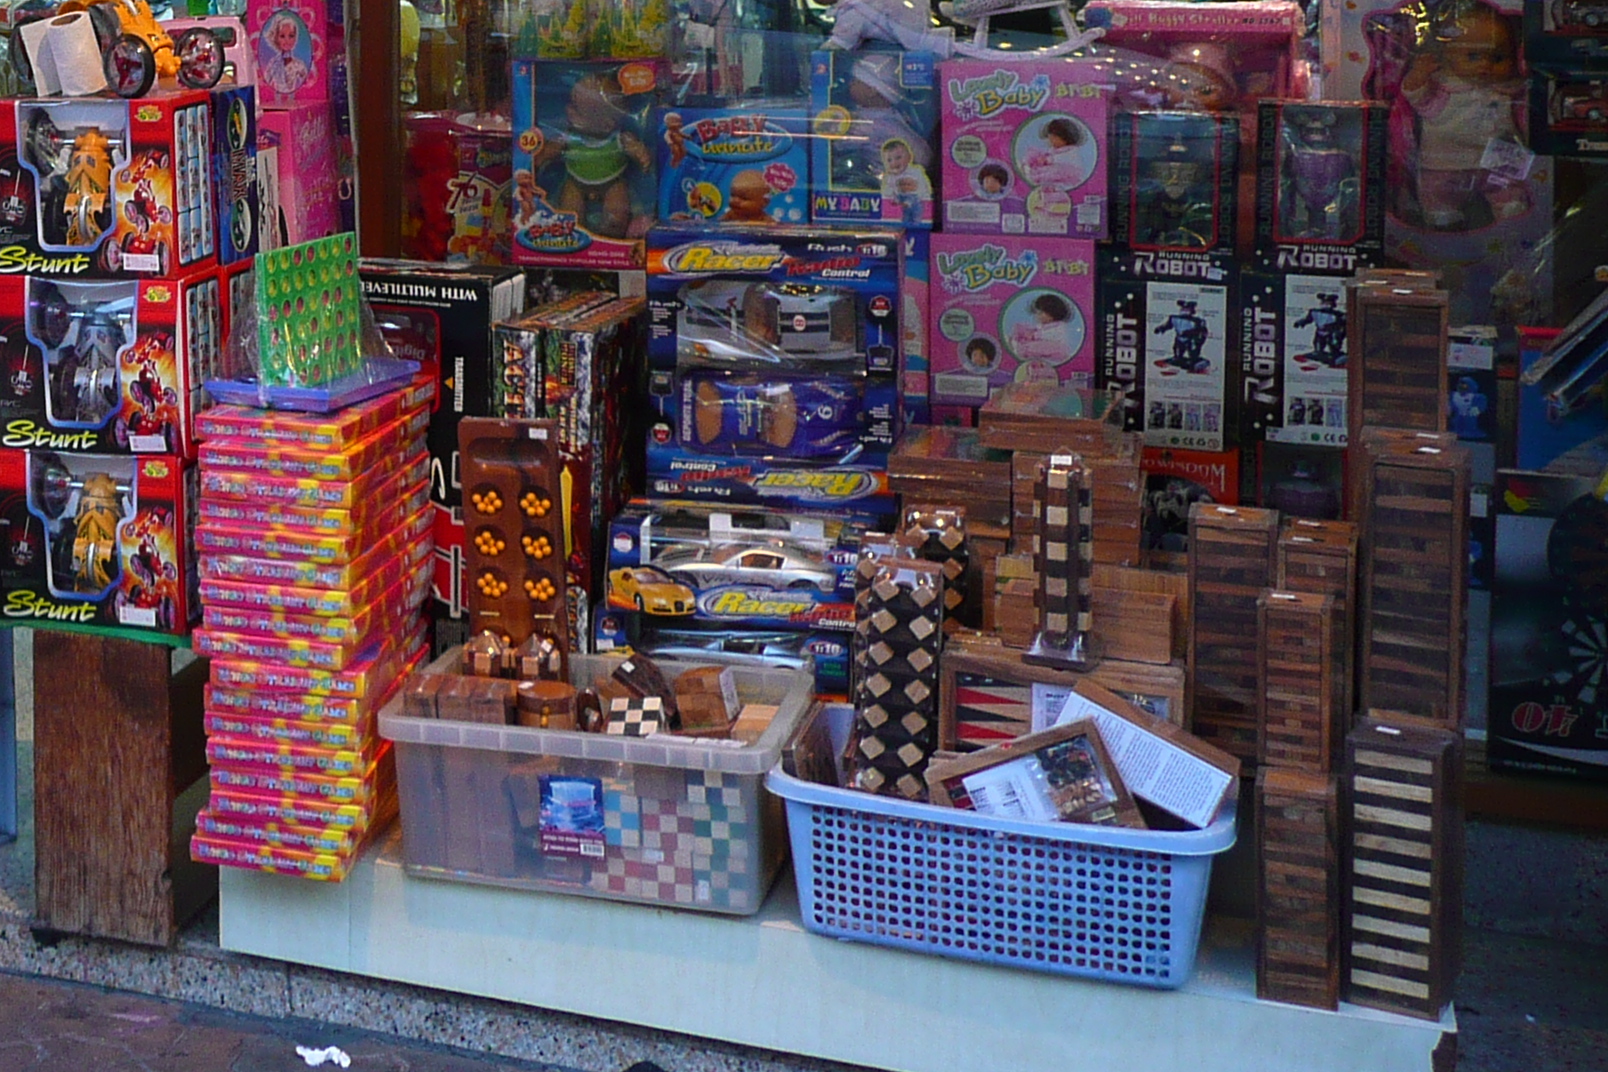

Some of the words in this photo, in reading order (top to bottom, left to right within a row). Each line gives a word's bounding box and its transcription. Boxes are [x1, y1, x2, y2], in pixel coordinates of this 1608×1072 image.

[975, 85, 1044, 115] Baby
[815, 197, 837, 211] MY
[840, 196, 882, 212] BABY
[678, 246, 780, 271] Racer
[1158, 251, 1211, 261] RUNNING
[1277, 244, 1358, 271] ROBOT
[1303, 244, 1357, 254] RUNNING
[822, 268, 871, 279] Control
[964, 261, 1033, 289] Baby
[1133, 252, 1212, 277] ROBOT
[441, 286, 478, 302] WITH
[1242, 307, 1252, 372] RUNNING
[1244, 306, 1278, 405] ROBOT
[2, 419, 99, 450] Stunt
[764, 471, 863, 496] Racer
[3, 589, 98, 622] Stunt
[708, 590, 813, 617] Racer
[819, 617, 857, 628] Contro
